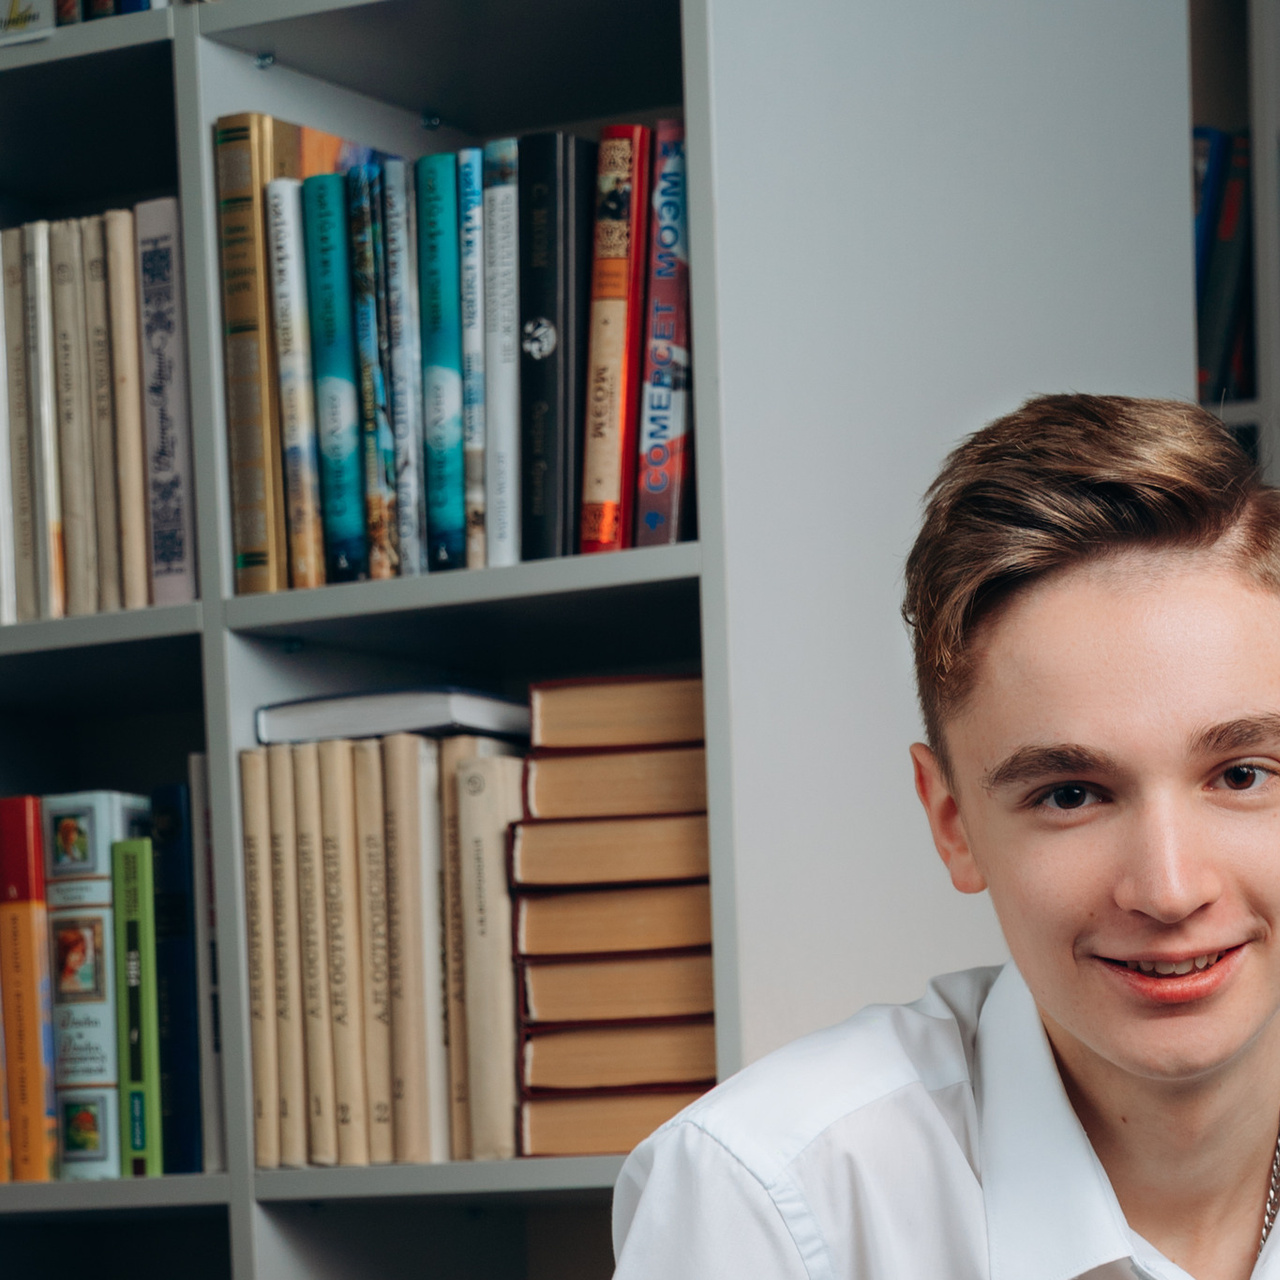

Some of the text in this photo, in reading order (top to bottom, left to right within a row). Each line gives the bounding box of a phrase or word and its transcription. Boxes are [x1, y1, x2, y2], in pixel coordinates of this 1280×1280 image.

[590, 366, 609, 438] МОЭМ
[644, 170, 681, 492] СОМЕРСЕТ МОЭМ
[322, 836, 346, 984] ОСТРОВСКИЙ
[366, 835, 388, 983] ОСТРОВСКИЙ
